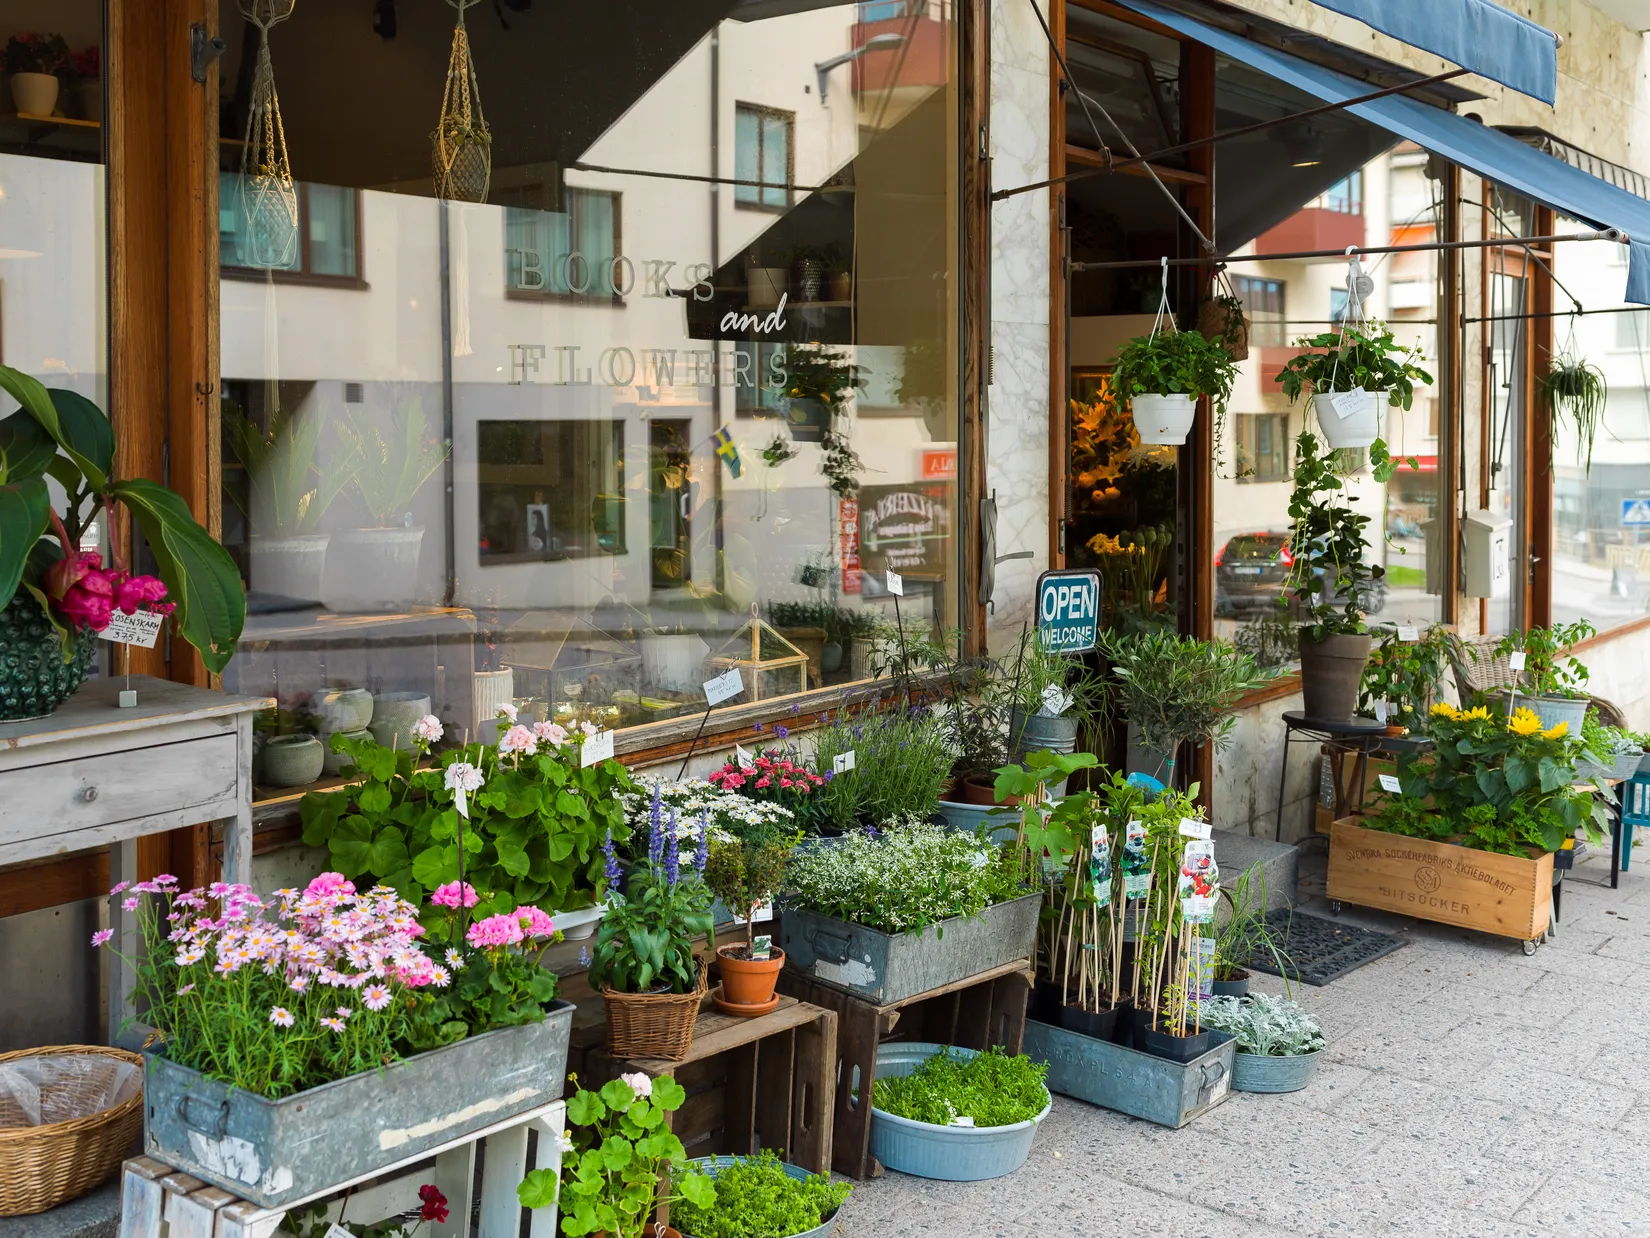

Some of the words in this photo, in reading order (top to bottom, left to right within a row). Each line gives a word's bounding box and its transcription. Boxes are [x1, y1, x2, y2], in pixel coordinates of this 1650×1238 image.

[516, 249, 715, 302] BOOKS
[720, 292, 788, 334] and
[516, 344, 788, 389] FLOWERS
[1043, 585, 1095, 621] OPEN
[1042, 625, 1092, 645] WELCOME
[1345, 849, 1381, 861] SVENSKA
[1455, 862, 1516, 895] AKTIEBOLAGET
[1383, 886, 1470, 915] BITSOCKER
